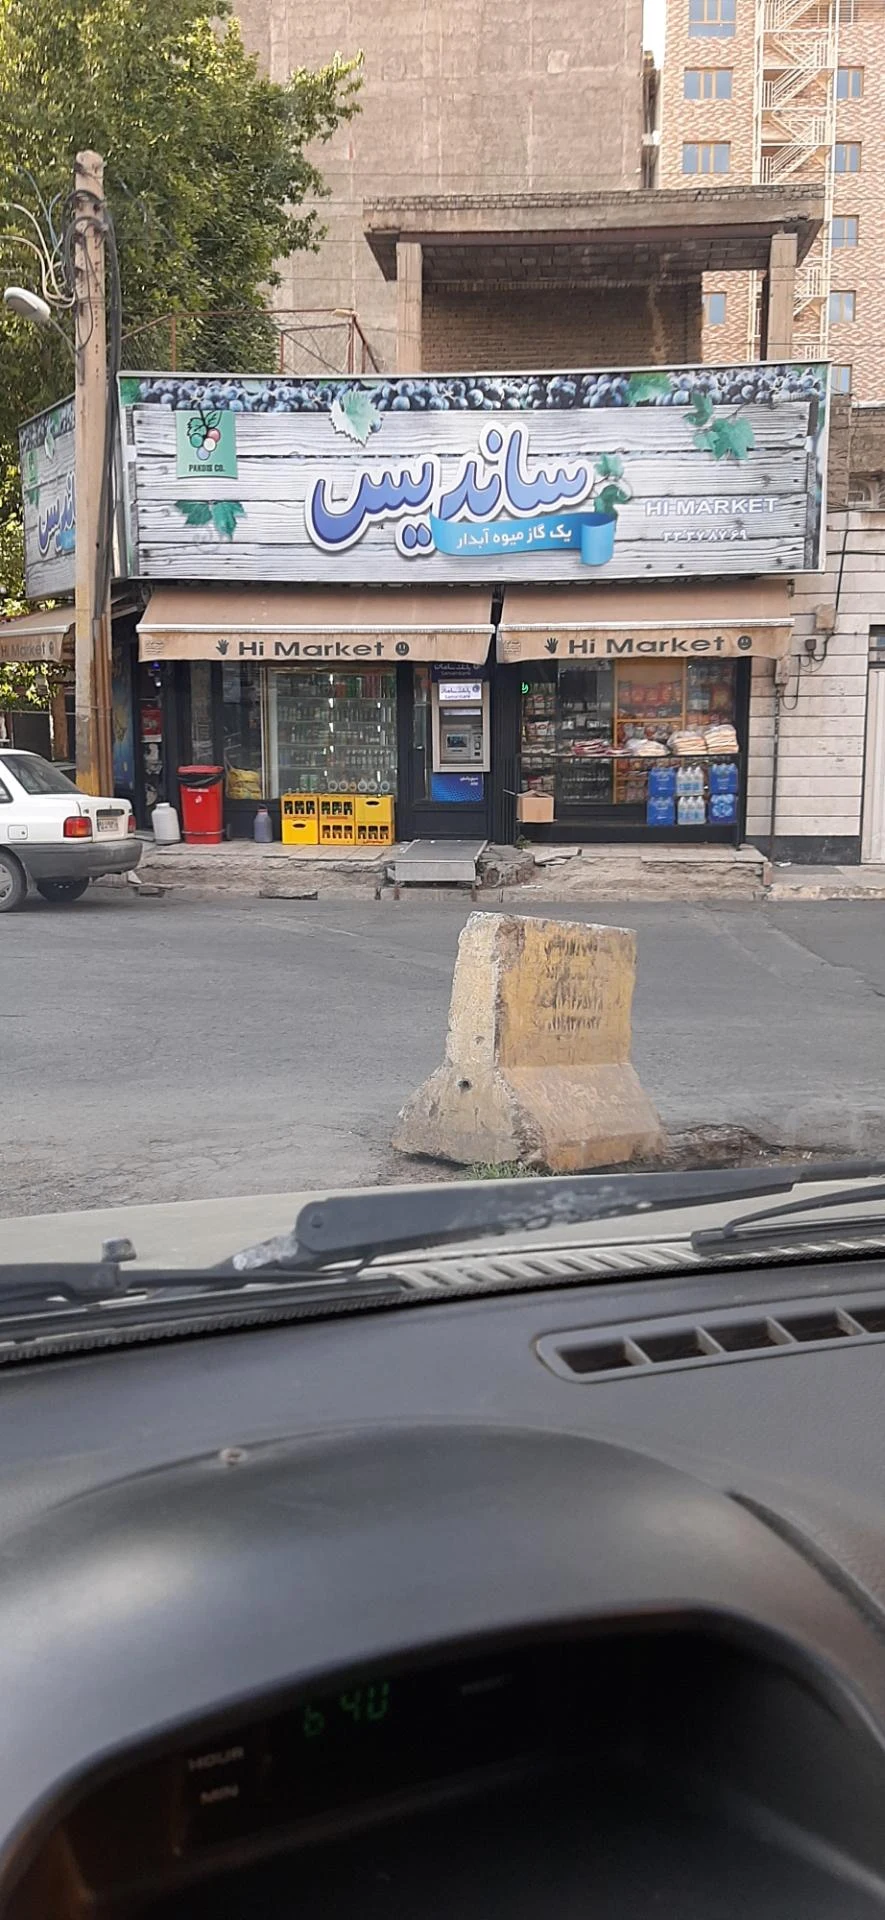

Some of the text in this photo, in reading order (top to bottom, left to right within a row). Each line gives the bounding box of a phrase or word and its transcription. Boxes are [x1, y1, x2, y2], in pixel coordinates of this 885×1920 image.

[309, 427, 589, 550] ساندیس
[646, 497, 779, 516] HI MARKET
[456, 523, 572, 550] یک گاز میوه آبدار
[11, 641, 45, 658] Market
[238, 641, 385, 657] Hi Market
[568, 636, 725, 654] Hi Market
